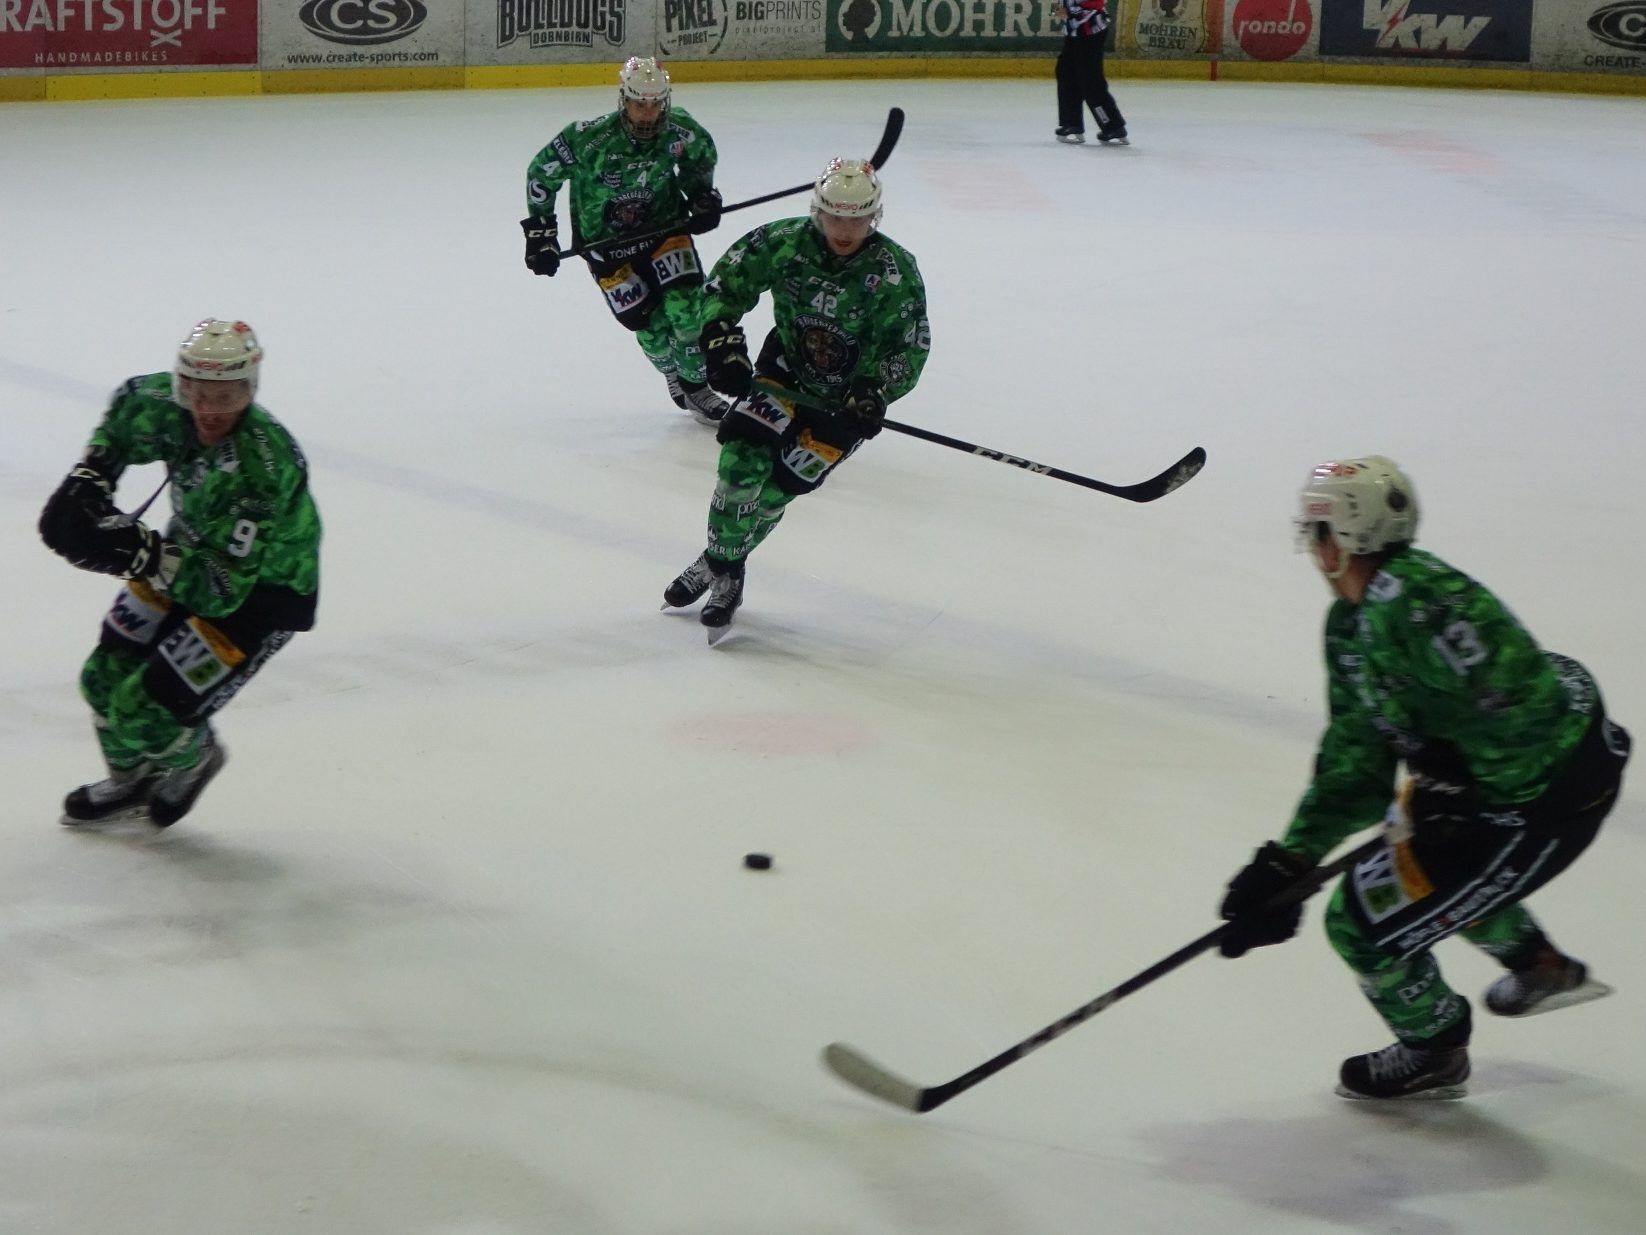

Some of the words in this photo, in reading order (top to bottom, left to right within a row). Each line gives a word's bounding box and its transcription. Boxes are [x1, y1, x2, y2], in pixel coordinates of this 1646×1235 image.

[330, 0, 397, 28] CS
[498, 0, 624, 43] BULLDOGS
[664, 0, 717, 32] PIXEL
[735, 1, 821, 20] BIGPRINTS
[887, 0, 1066, 37] MOHRE
[1238, 0, 1306, 43] rondo
[532, 29, 590, 44] DORNBIRN
[1138, 22, 1198, 39] MOHREN
[1363, 0, 1492, 50] VKW
[678, 31, 708, 46] PROJECT
[35, 51, 168, 63] HANDMADEBIKES
[287, 50, 438, 64] www.create-sports.com
[636, 170, 648, 188] 4
[609, 244, 638, 260] TONE
[810, 290, 838, 319] 42
[228, 519, 257, 558] 9
